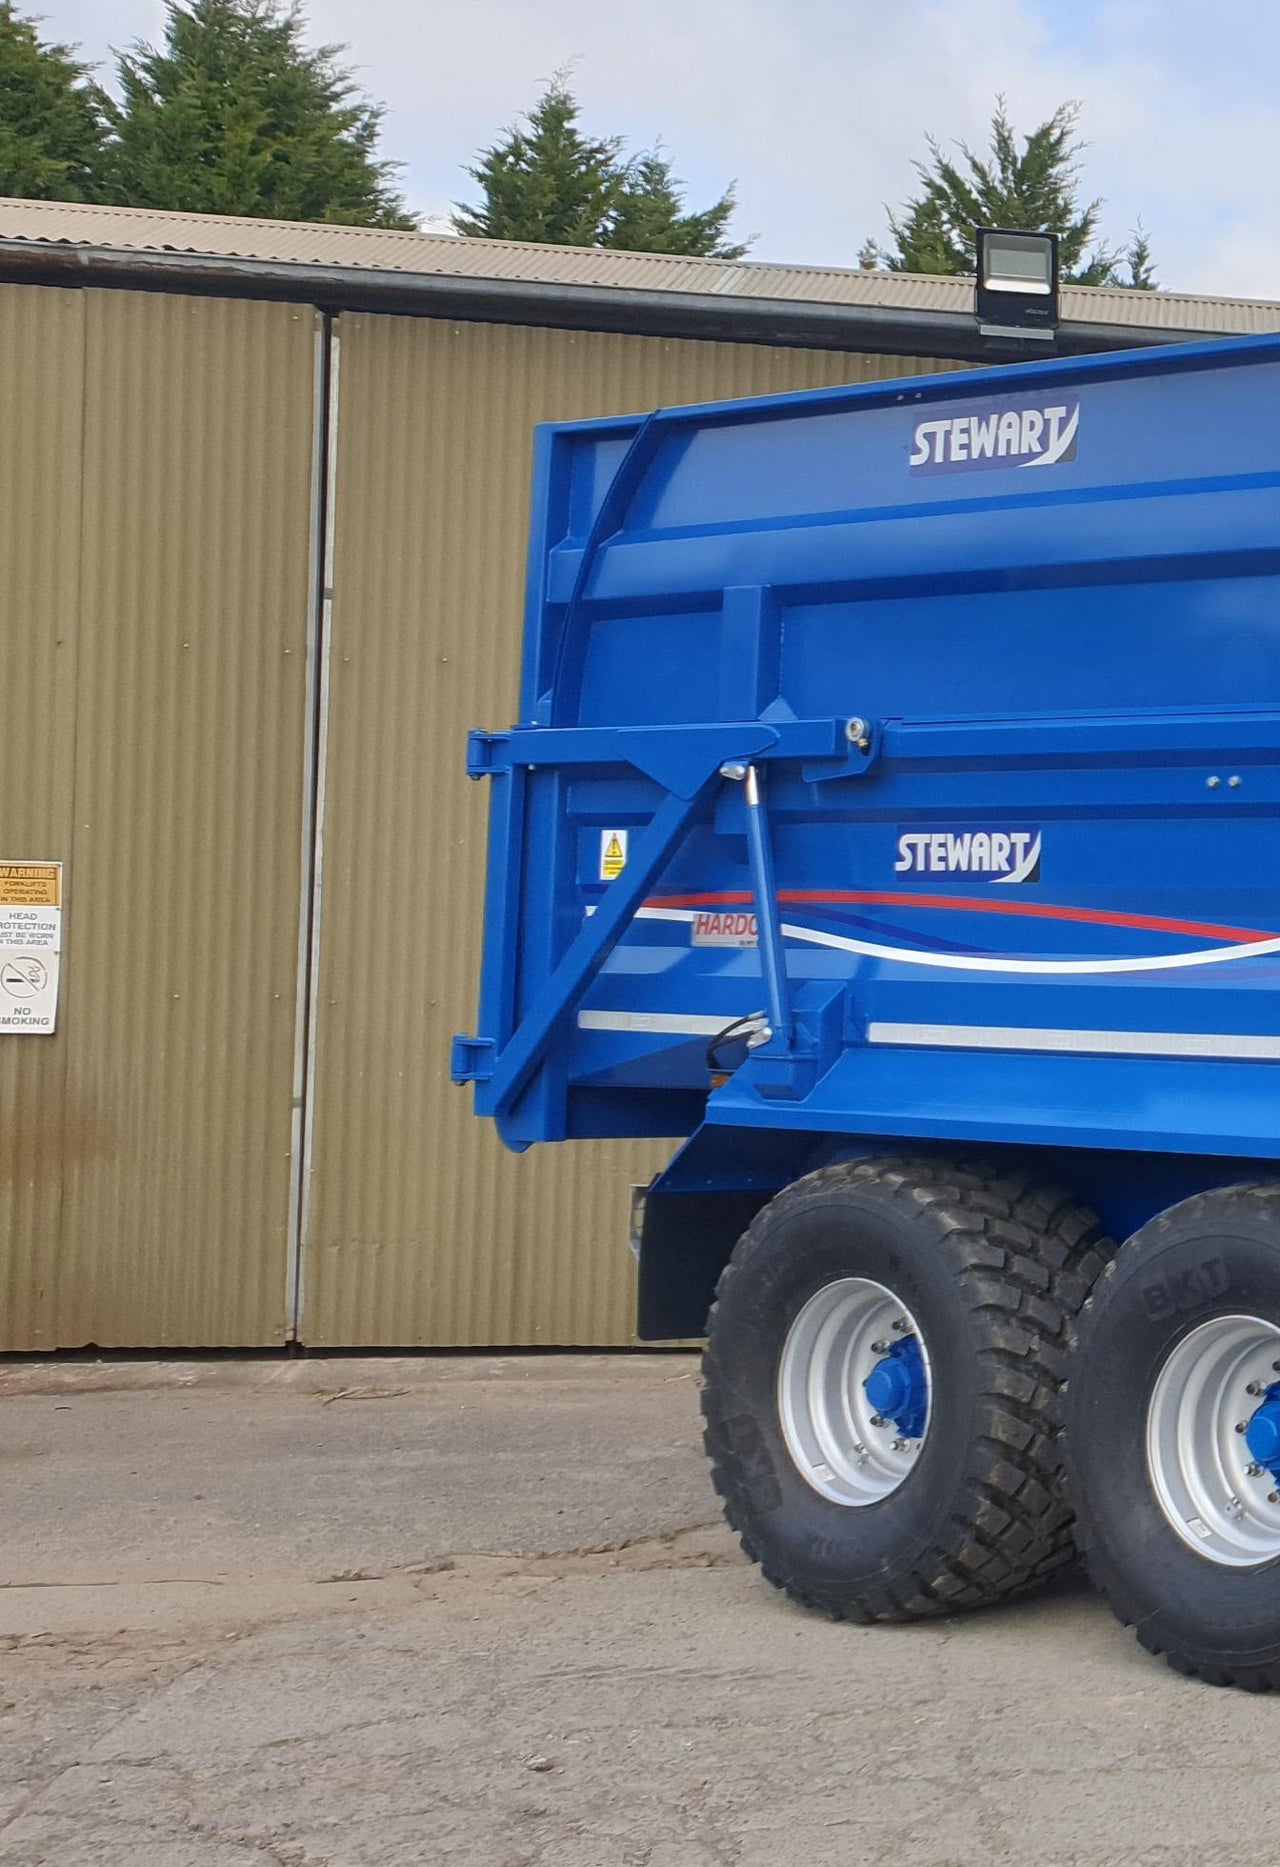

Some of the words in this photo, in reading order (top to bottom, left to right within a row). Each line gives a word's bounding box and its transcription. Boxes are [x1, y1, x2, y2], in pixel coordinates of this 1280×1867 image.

[909, 402, 1080, 467] STEWART
[895, 830, 1041, 883] STEWART
[0, 867, 56, 879] WARNING
[9, 912, 37, 920] HEAD
[695, 913, 758, 936] HARDO
[13, 1007, 31, 1016] NO
